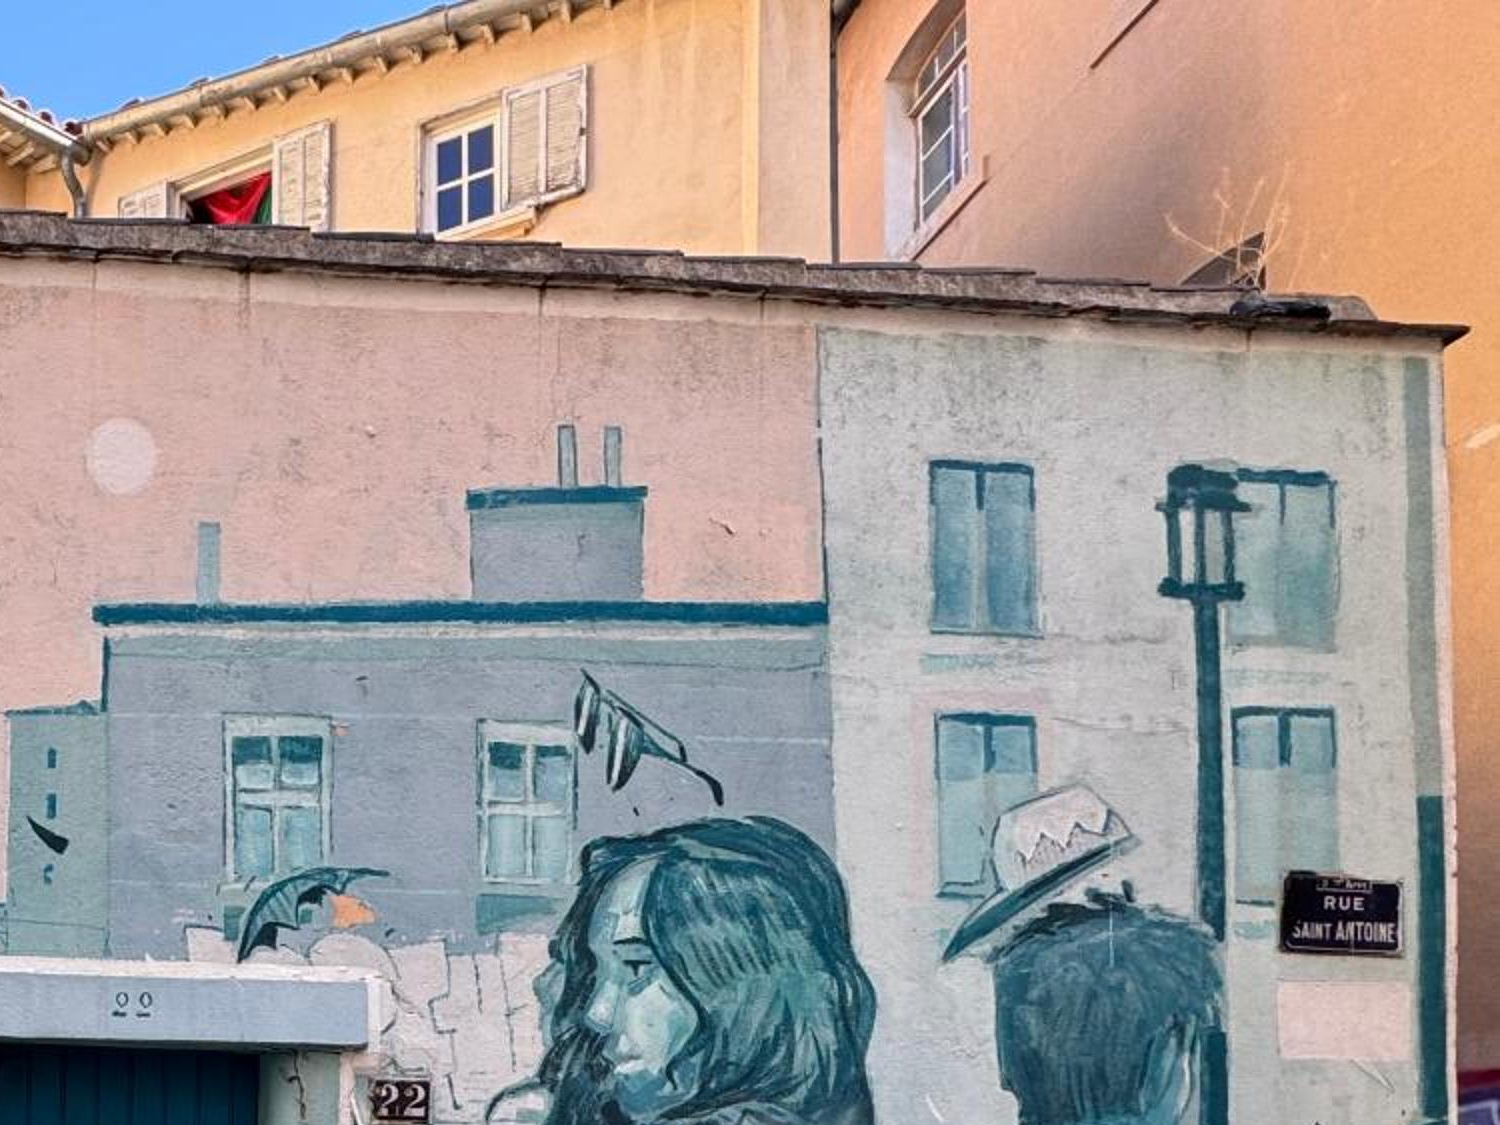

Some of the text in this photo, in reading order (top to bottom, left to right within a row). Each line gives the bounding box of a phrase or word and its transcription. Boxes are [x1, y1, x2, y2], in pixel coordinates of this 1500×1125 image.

[1323, 895, 1364, 911] RUE
[1292, 920, 1396, 943] SAINT ANTOINE
[378, 1083, 426, 1117] 22
